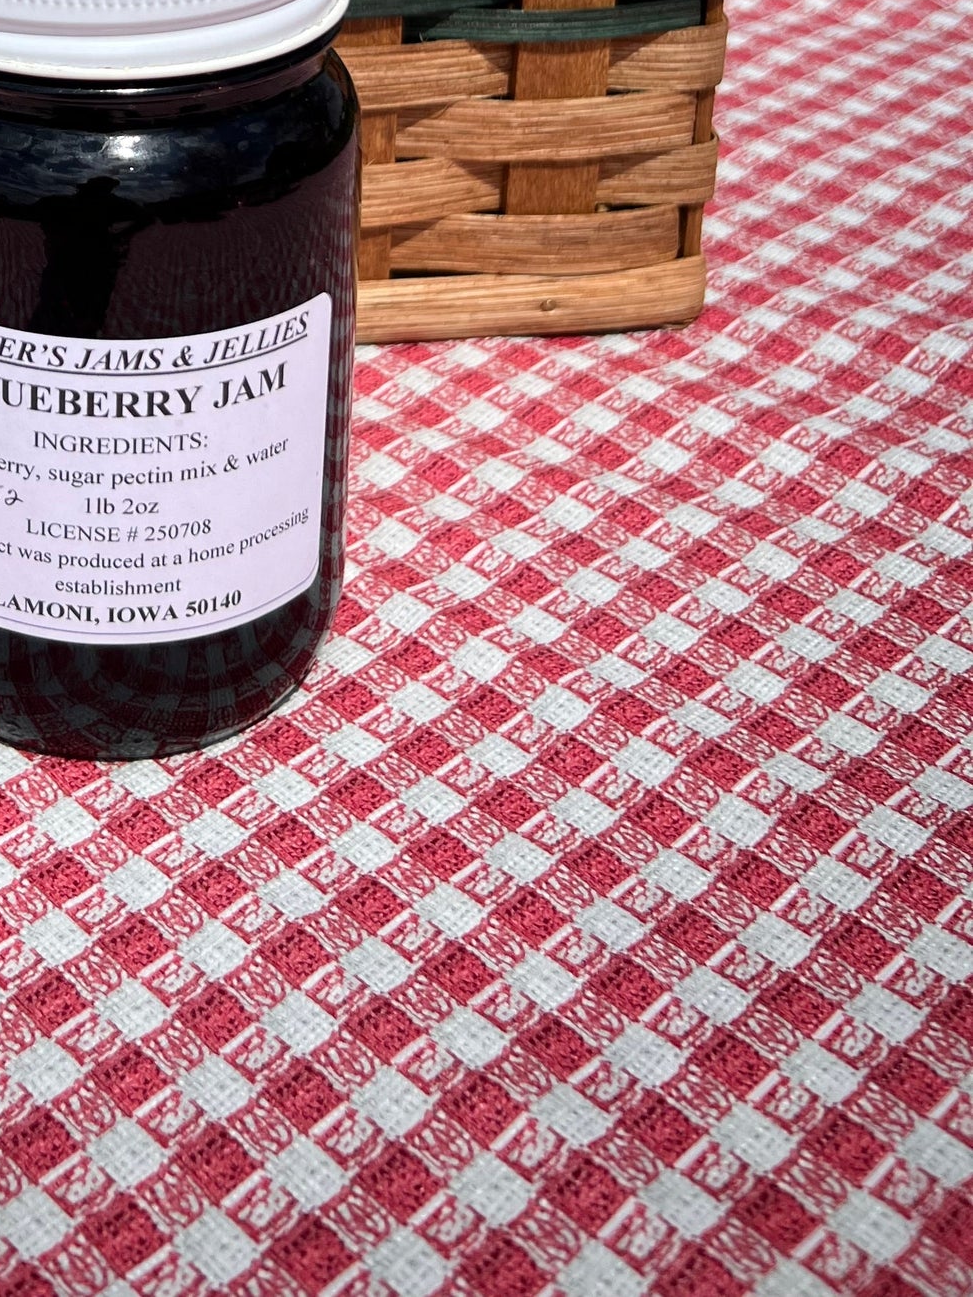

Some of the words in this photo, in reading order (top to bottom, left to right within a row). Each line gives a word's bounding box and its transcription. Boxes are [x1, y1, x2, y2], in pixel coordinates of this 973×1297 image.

[74, 347, 163, 371] JAMS
[172, 346, 194, 367] &
[202, 310, 311, 364] JELLIES
[213, 361, 288, 408] JAM
[33, 430, 209, 455] INGREDIENTS:
[48, 467, 105, 488] sugar
[111, 467, 173, 489] pectin
[179, 460, 217, 480] mix
[222, 455, 240, 472] &
[247, 438, 290, 466] water
[83, 496, 115, 514] 1lb
[122, 497, 159, 514] 2oz
[18, 547, 52, 563] was
[58, 552, 145, 571] produced
[151, 552, 168, 567] at
[172, 553, 183, 565] a
[188, 541, 235, 562] home
[239, 505, 310, 555] processing
[26, 517, 121, 542] LICENSE
[126, 524, 139, 541] #
[144, 518, 212, 542] 250708
[55, 577, 182, 595] establishment
[106, 603, 179, 623] IOWA
[184, 589, 242, 617] 50140
